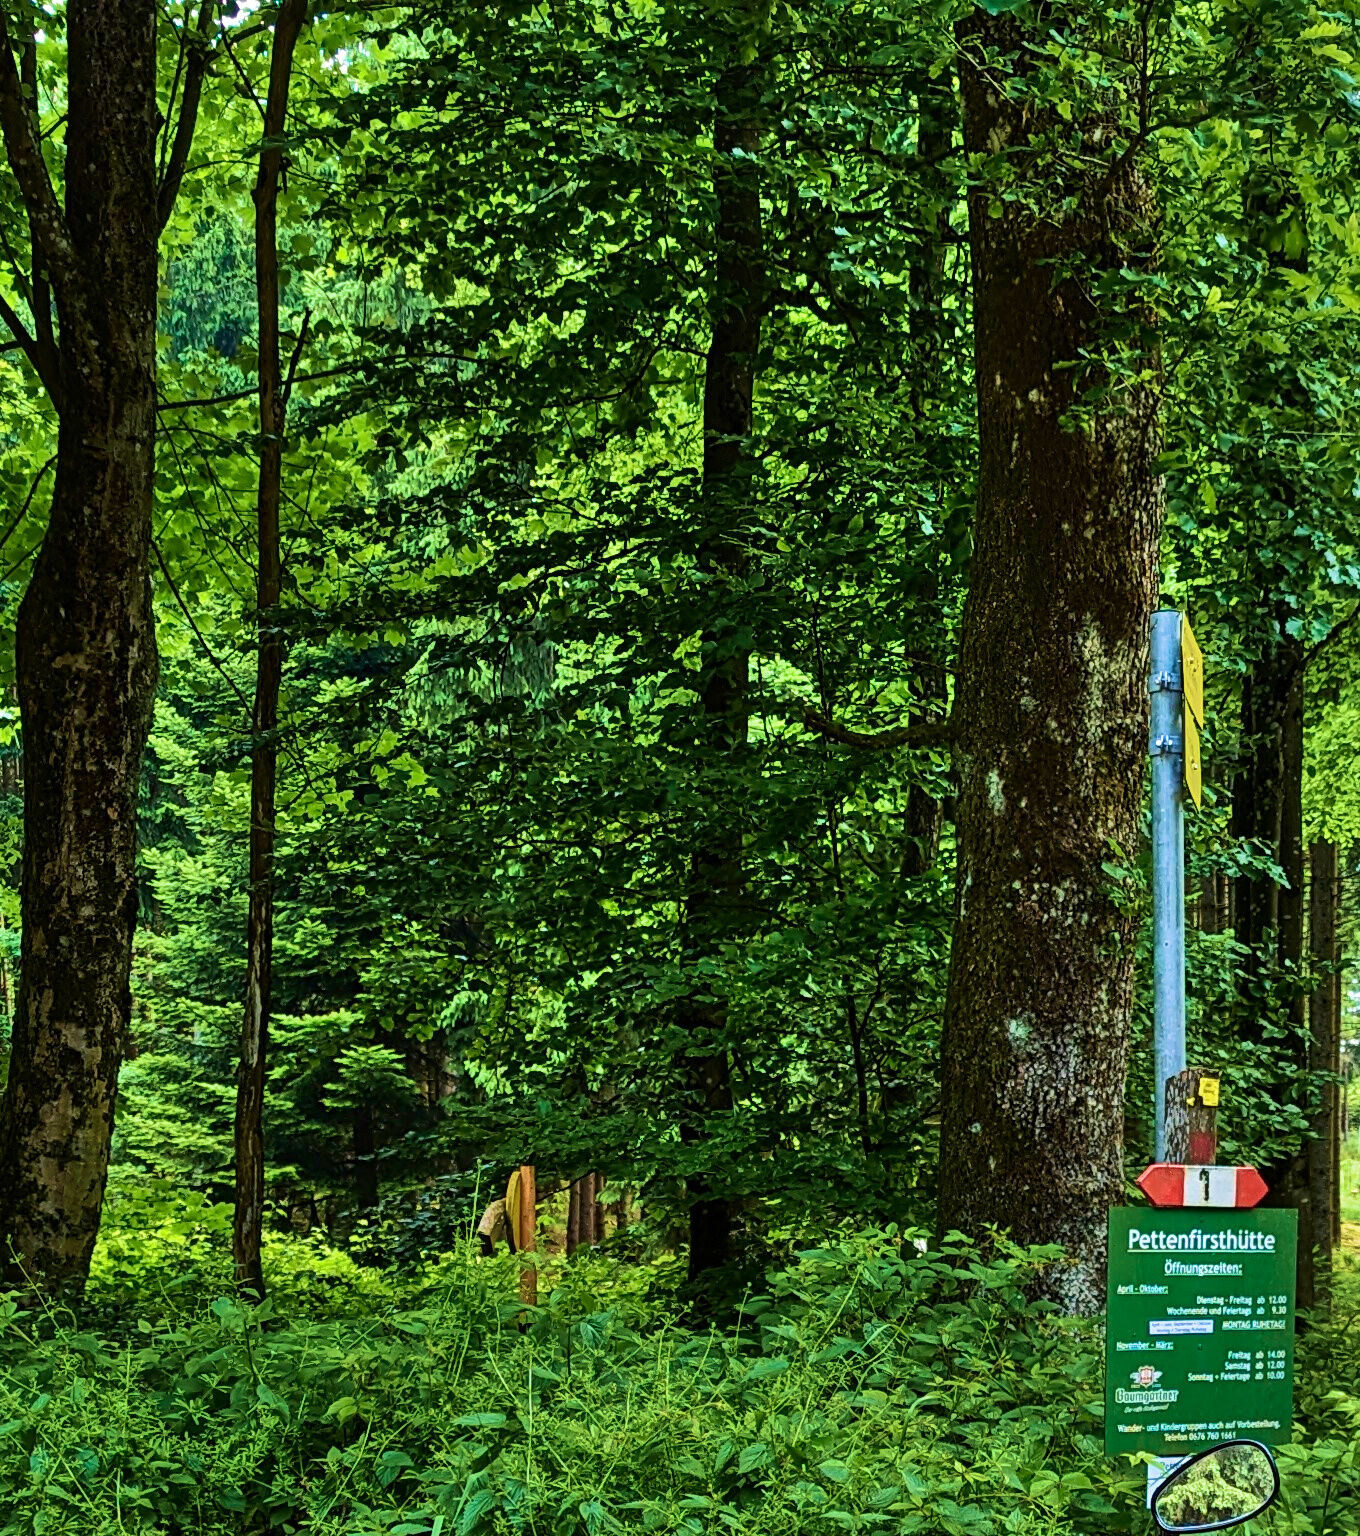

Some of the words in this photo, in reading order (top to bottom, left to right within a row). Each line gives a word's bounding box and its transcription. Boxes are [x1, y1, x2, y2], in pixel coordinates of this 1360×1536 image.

[1198, 1168, 1210, 1202] 1
[1128, 1229, 1275, 1251] Pettenfirsthütte
[1164, 1259, 1242, 1276] Öffnungszeiten:
[1117, 1285, 1134, 1295] April
[1139, 1285, 1168, 1295] Oktober:
[1196, 1296, 1224, 1305] Dienstag
[1229, 1296, 1252, 1305] Freitag
[1257, 1296, 1265, 1304] ab
[1268, 1295, 1287, 1304] 12.00
[1167, 1307, 1208, 1315] Wochenende
[1209, 1307, 1221, 1315] und
[1257, 1306, 1265, 1315] ab
[1222, 1321, 1251, 1330] MONTAG
[1252, 1320, 1286, 1330] RUHETAG!
[1117, 1342, 1149, 1350] November
[1155, 1341, 1174, 1350] März:
[1228, 1352, 1251, 1360] Freitag
[1255, 1351, 1264, 1359] ab
[1267, 1350, 1286, 1359] 14.00
[1225, 1362, 1251, 1371] Samstag
[1255, 1362, 1264, 1370] ab
[1267, 1361, 1286, 1369] 12.00
[1188, 1373, 1214, 1382] Sonntag
[1220, 1372, 1251, 1381] Feiertage
[1255, 1371, 1264, 1380] ab
[1266, 1371, 1285, 1380] 10.00
[1117, 1424, 1145, 1433] Wander-
[1147, 1423, 1159, 1432] und
[1160, 1422, 1208, 1432] Kindergruppen
[1208, 1421, 1224, 1430] auch
[1225, 1420, 1236, 1429] auf
[1237, 1420, 1281, 1430] Vorbestellung.
[1164, 1433, 1188, 1441] Telefon
[1189, 1432, 1206, 1441] 0676
[1221, 1431, 1237, 1440] 1661
